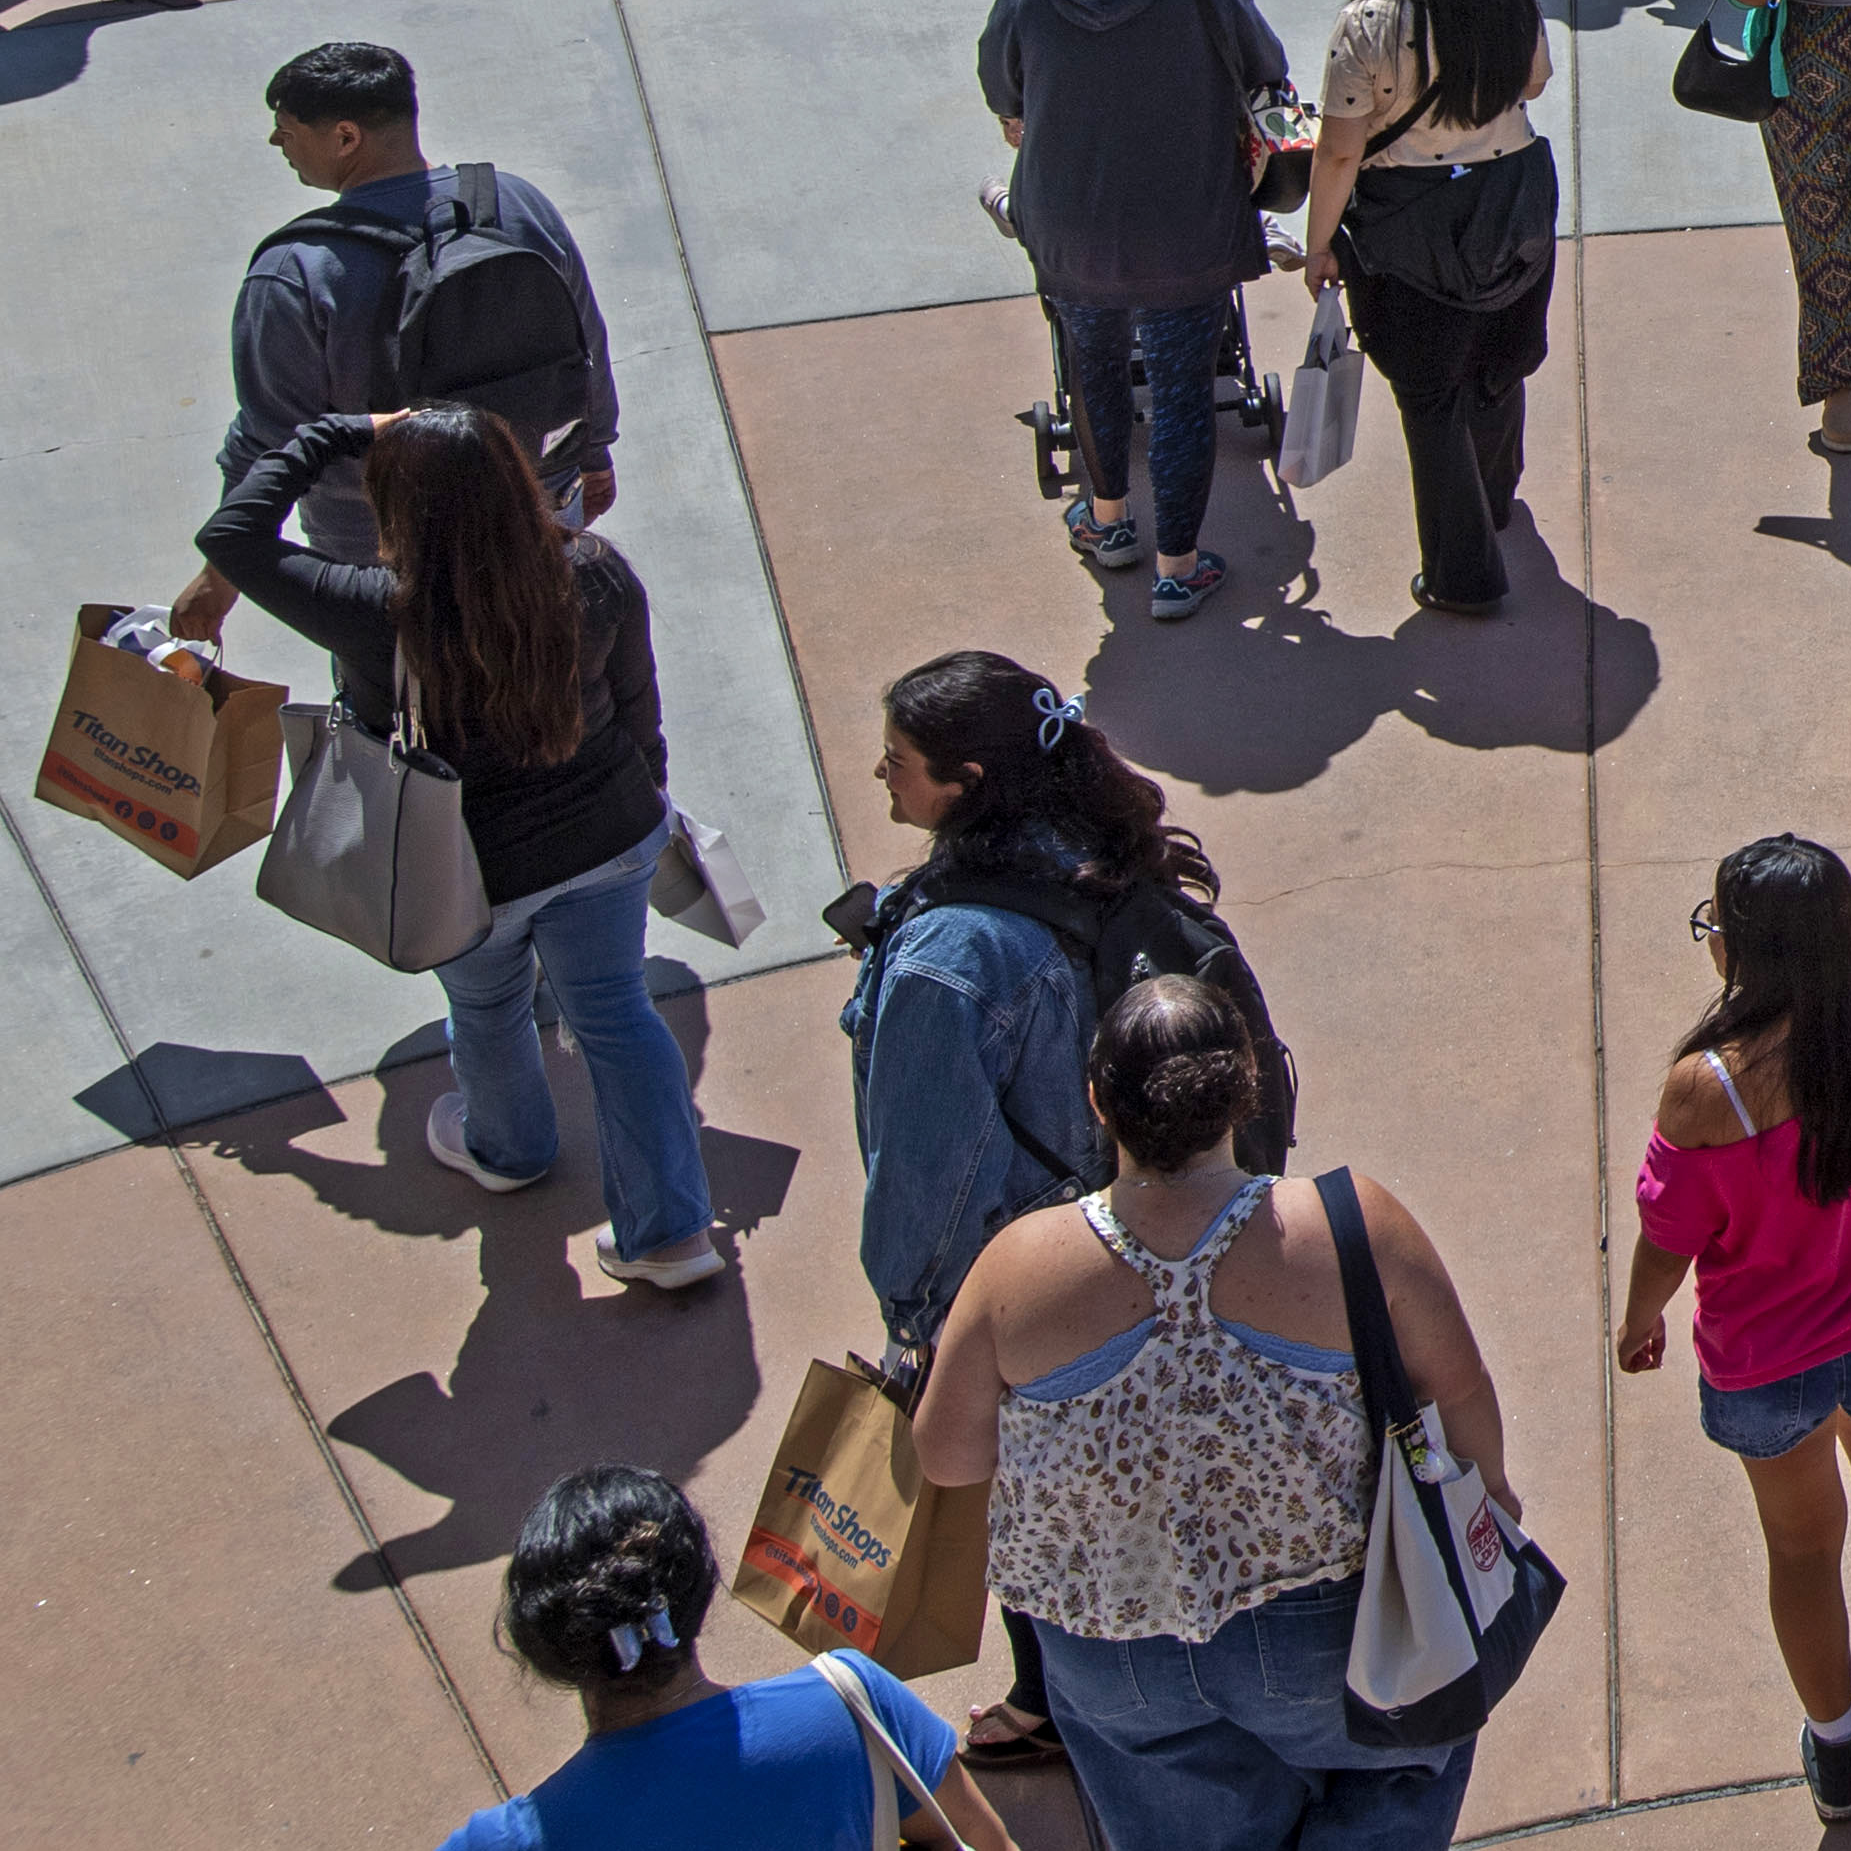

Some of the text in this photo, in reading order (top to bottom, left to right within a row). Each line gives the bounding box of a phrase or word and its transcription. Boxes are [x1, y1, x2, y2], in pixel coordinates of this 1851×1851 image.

[72, 710, 129, 757] Titan
[93, 747, 174, 797] titanshops.com
[785, 1465, 892, 1569] Titan Shops
